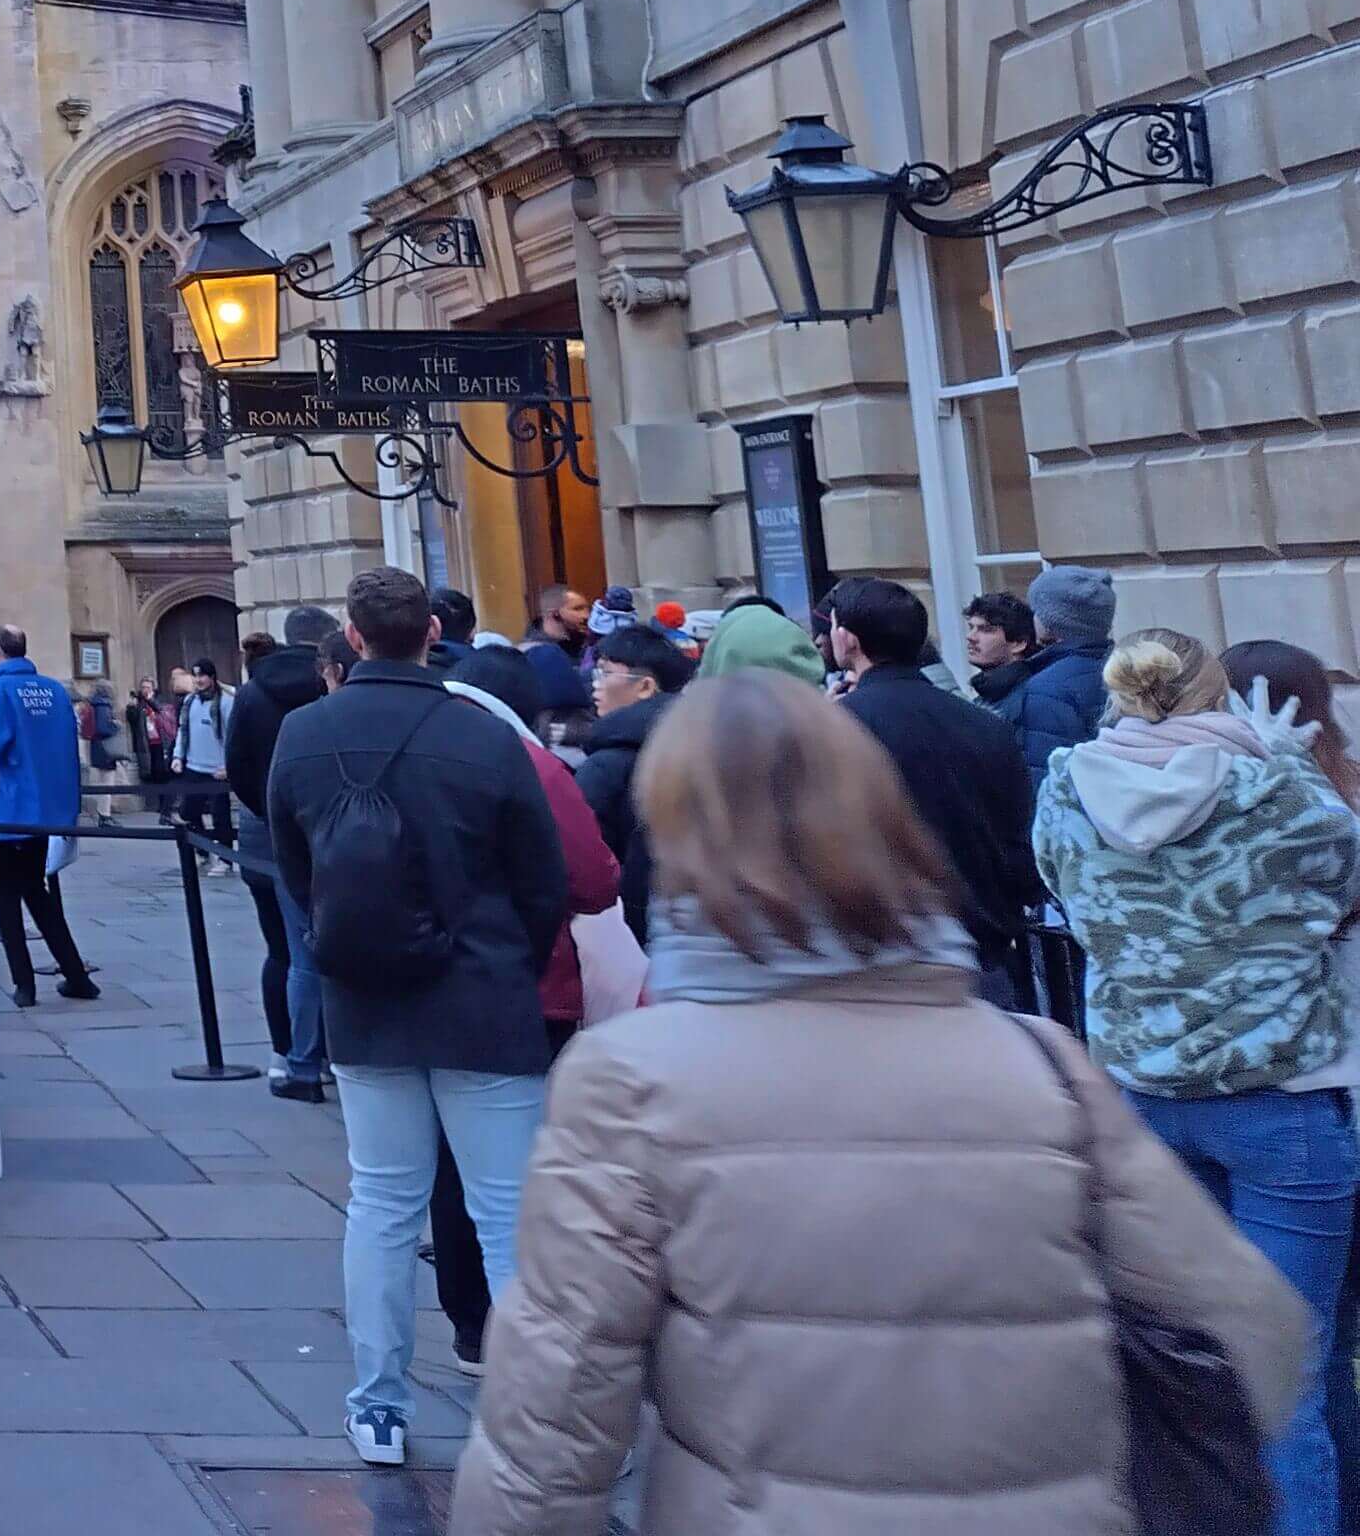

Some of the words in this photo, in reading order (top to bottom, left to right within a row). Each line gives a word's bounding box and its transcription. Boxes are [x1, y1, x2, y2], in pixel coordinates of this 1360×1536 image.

[420, 357, 458, 374] THE
[361, 375, 440, 393] ROMAN
[458, 376, 520, 394] BATHS
[248, 411, 320, 427] ROMAN
[337, 410, 390, 427] BATHS
[16, 687, 53, 697] ROMAN
[23, 697, 52, 708] BATHS
